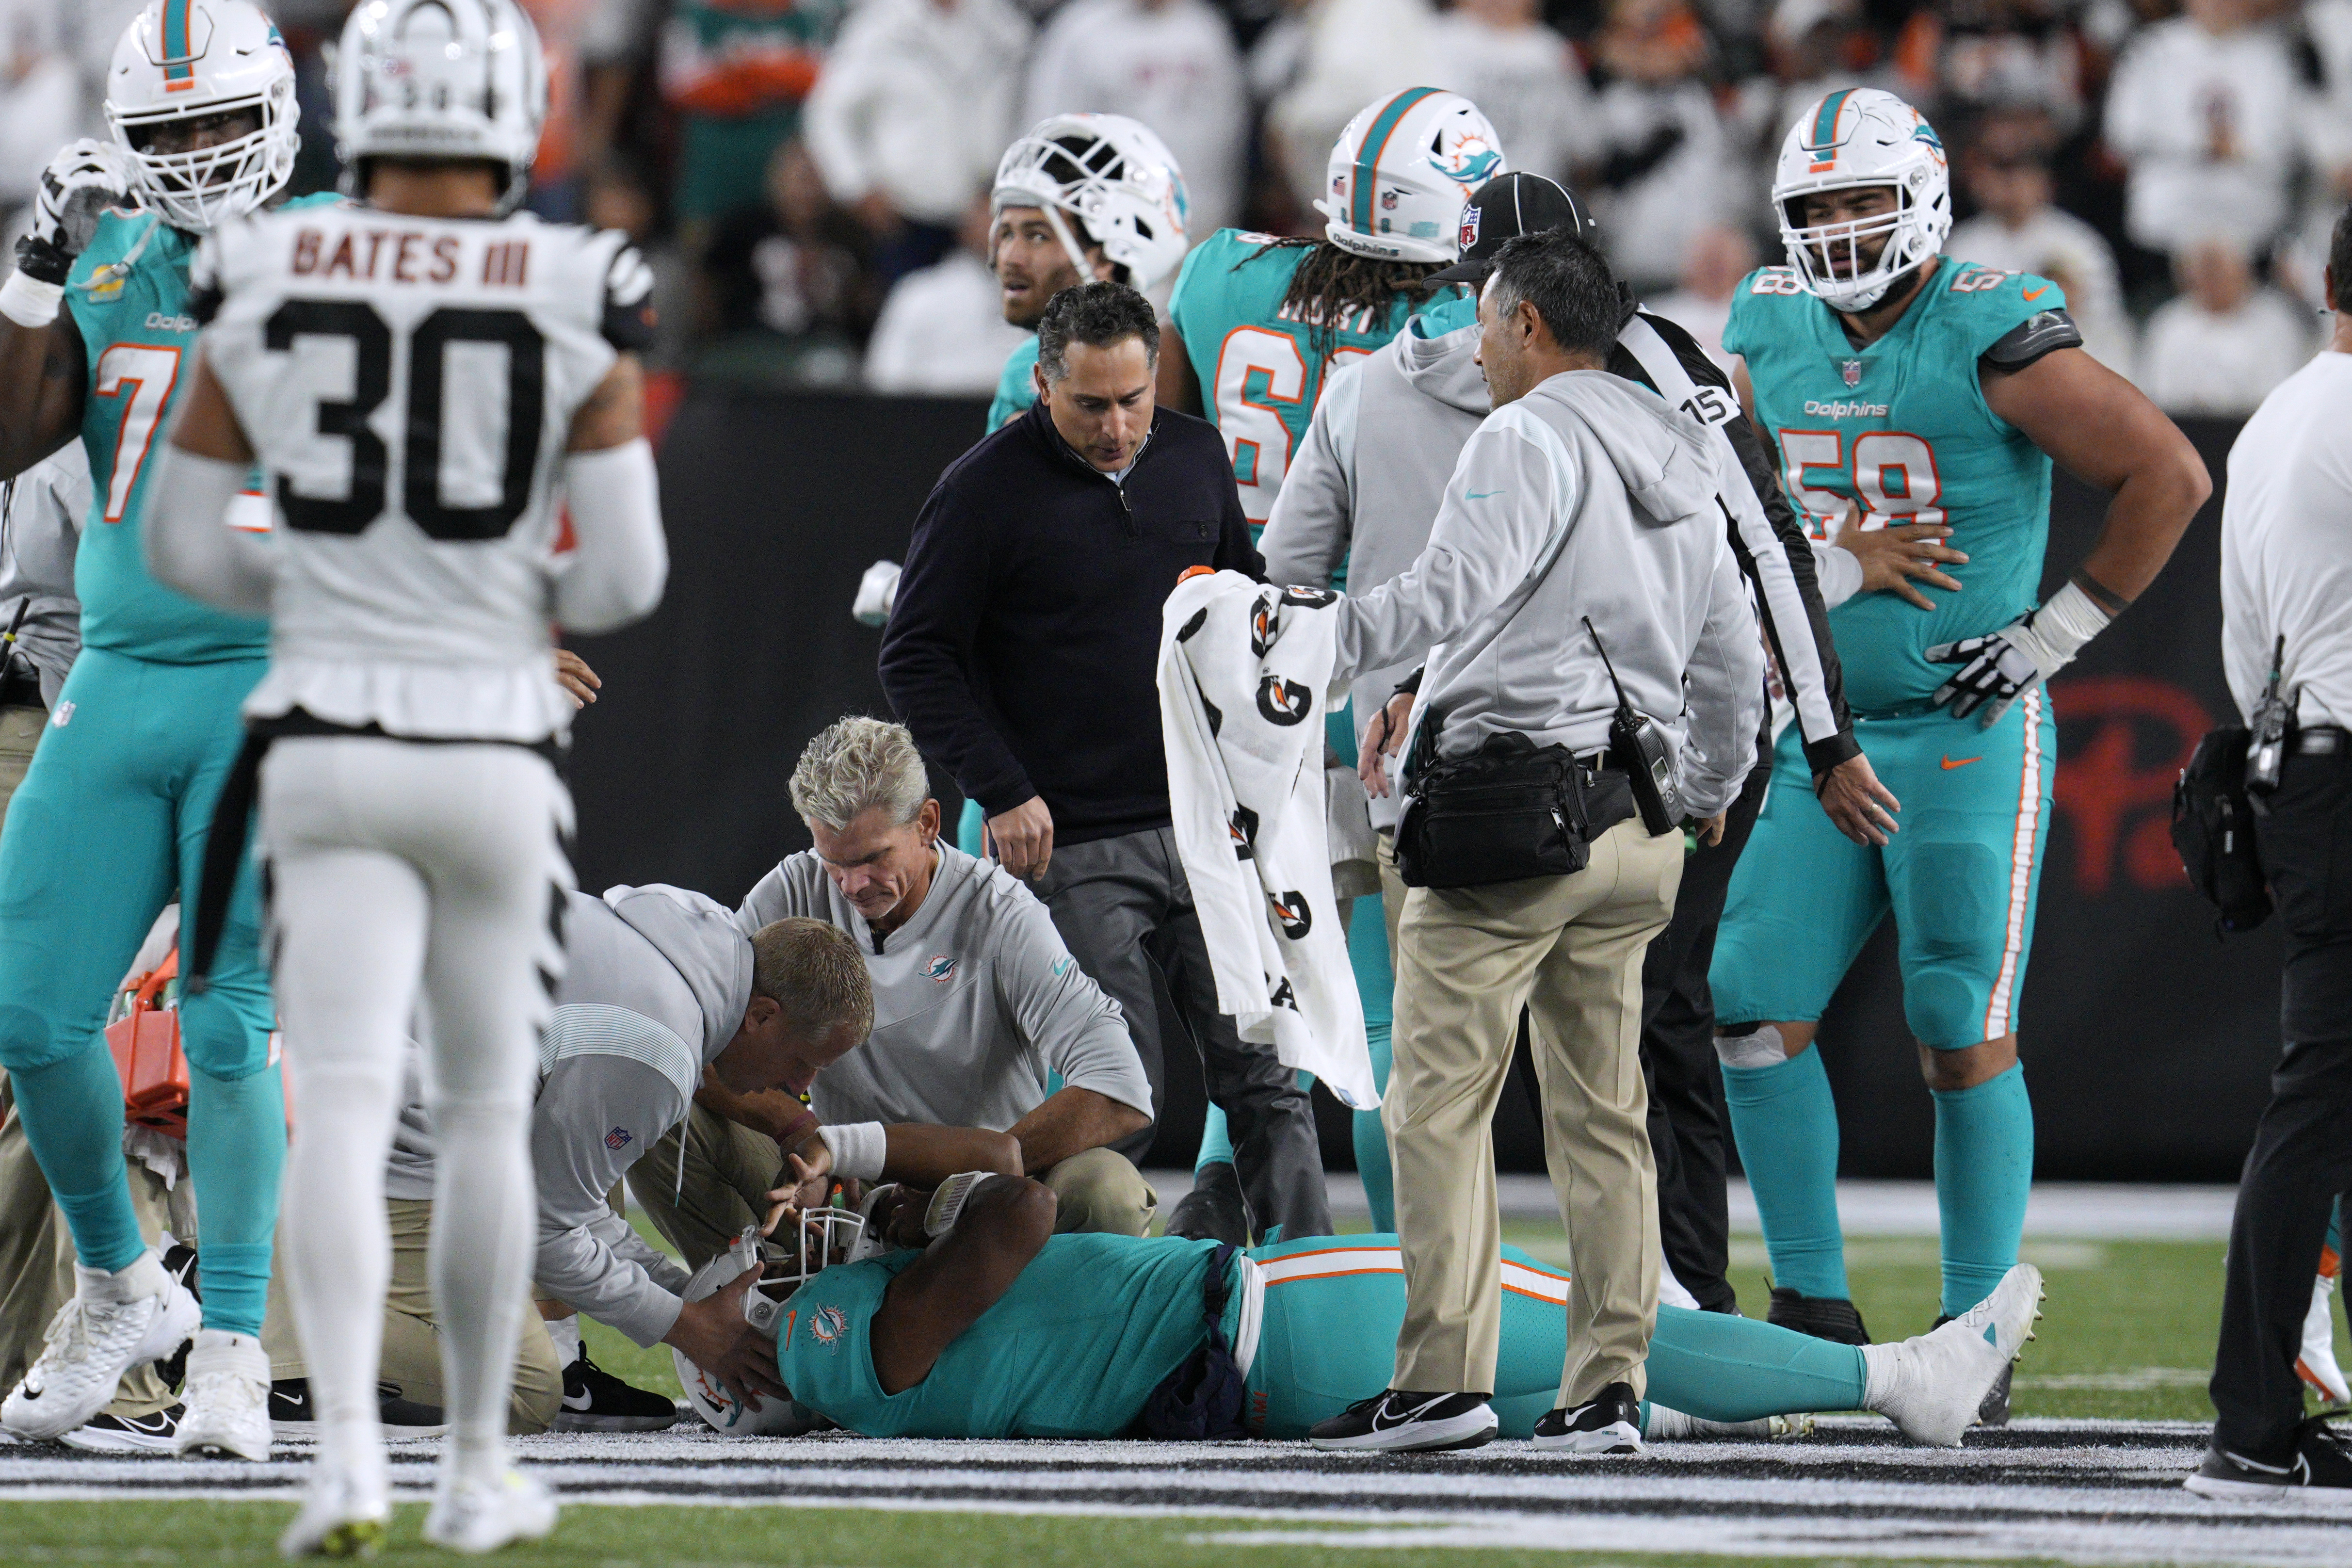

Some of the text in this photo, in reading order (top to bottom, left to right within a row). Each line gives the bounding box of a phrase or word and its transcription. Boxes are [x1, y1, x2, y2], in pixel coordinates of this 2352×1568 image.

[292, 228, 529, 287] BATES III
[1333, 232, 1401, 257] Dolphins
[145, 312, 198, 335] Dolp
[265, 299, 545, 540] 30
[1804, 400, 1889, 421] Dolphins
[1778, 428, 1948, 568] 58
[1256, 675, 1312, 726] G
[607, 1133, 623, 1148] NFL
